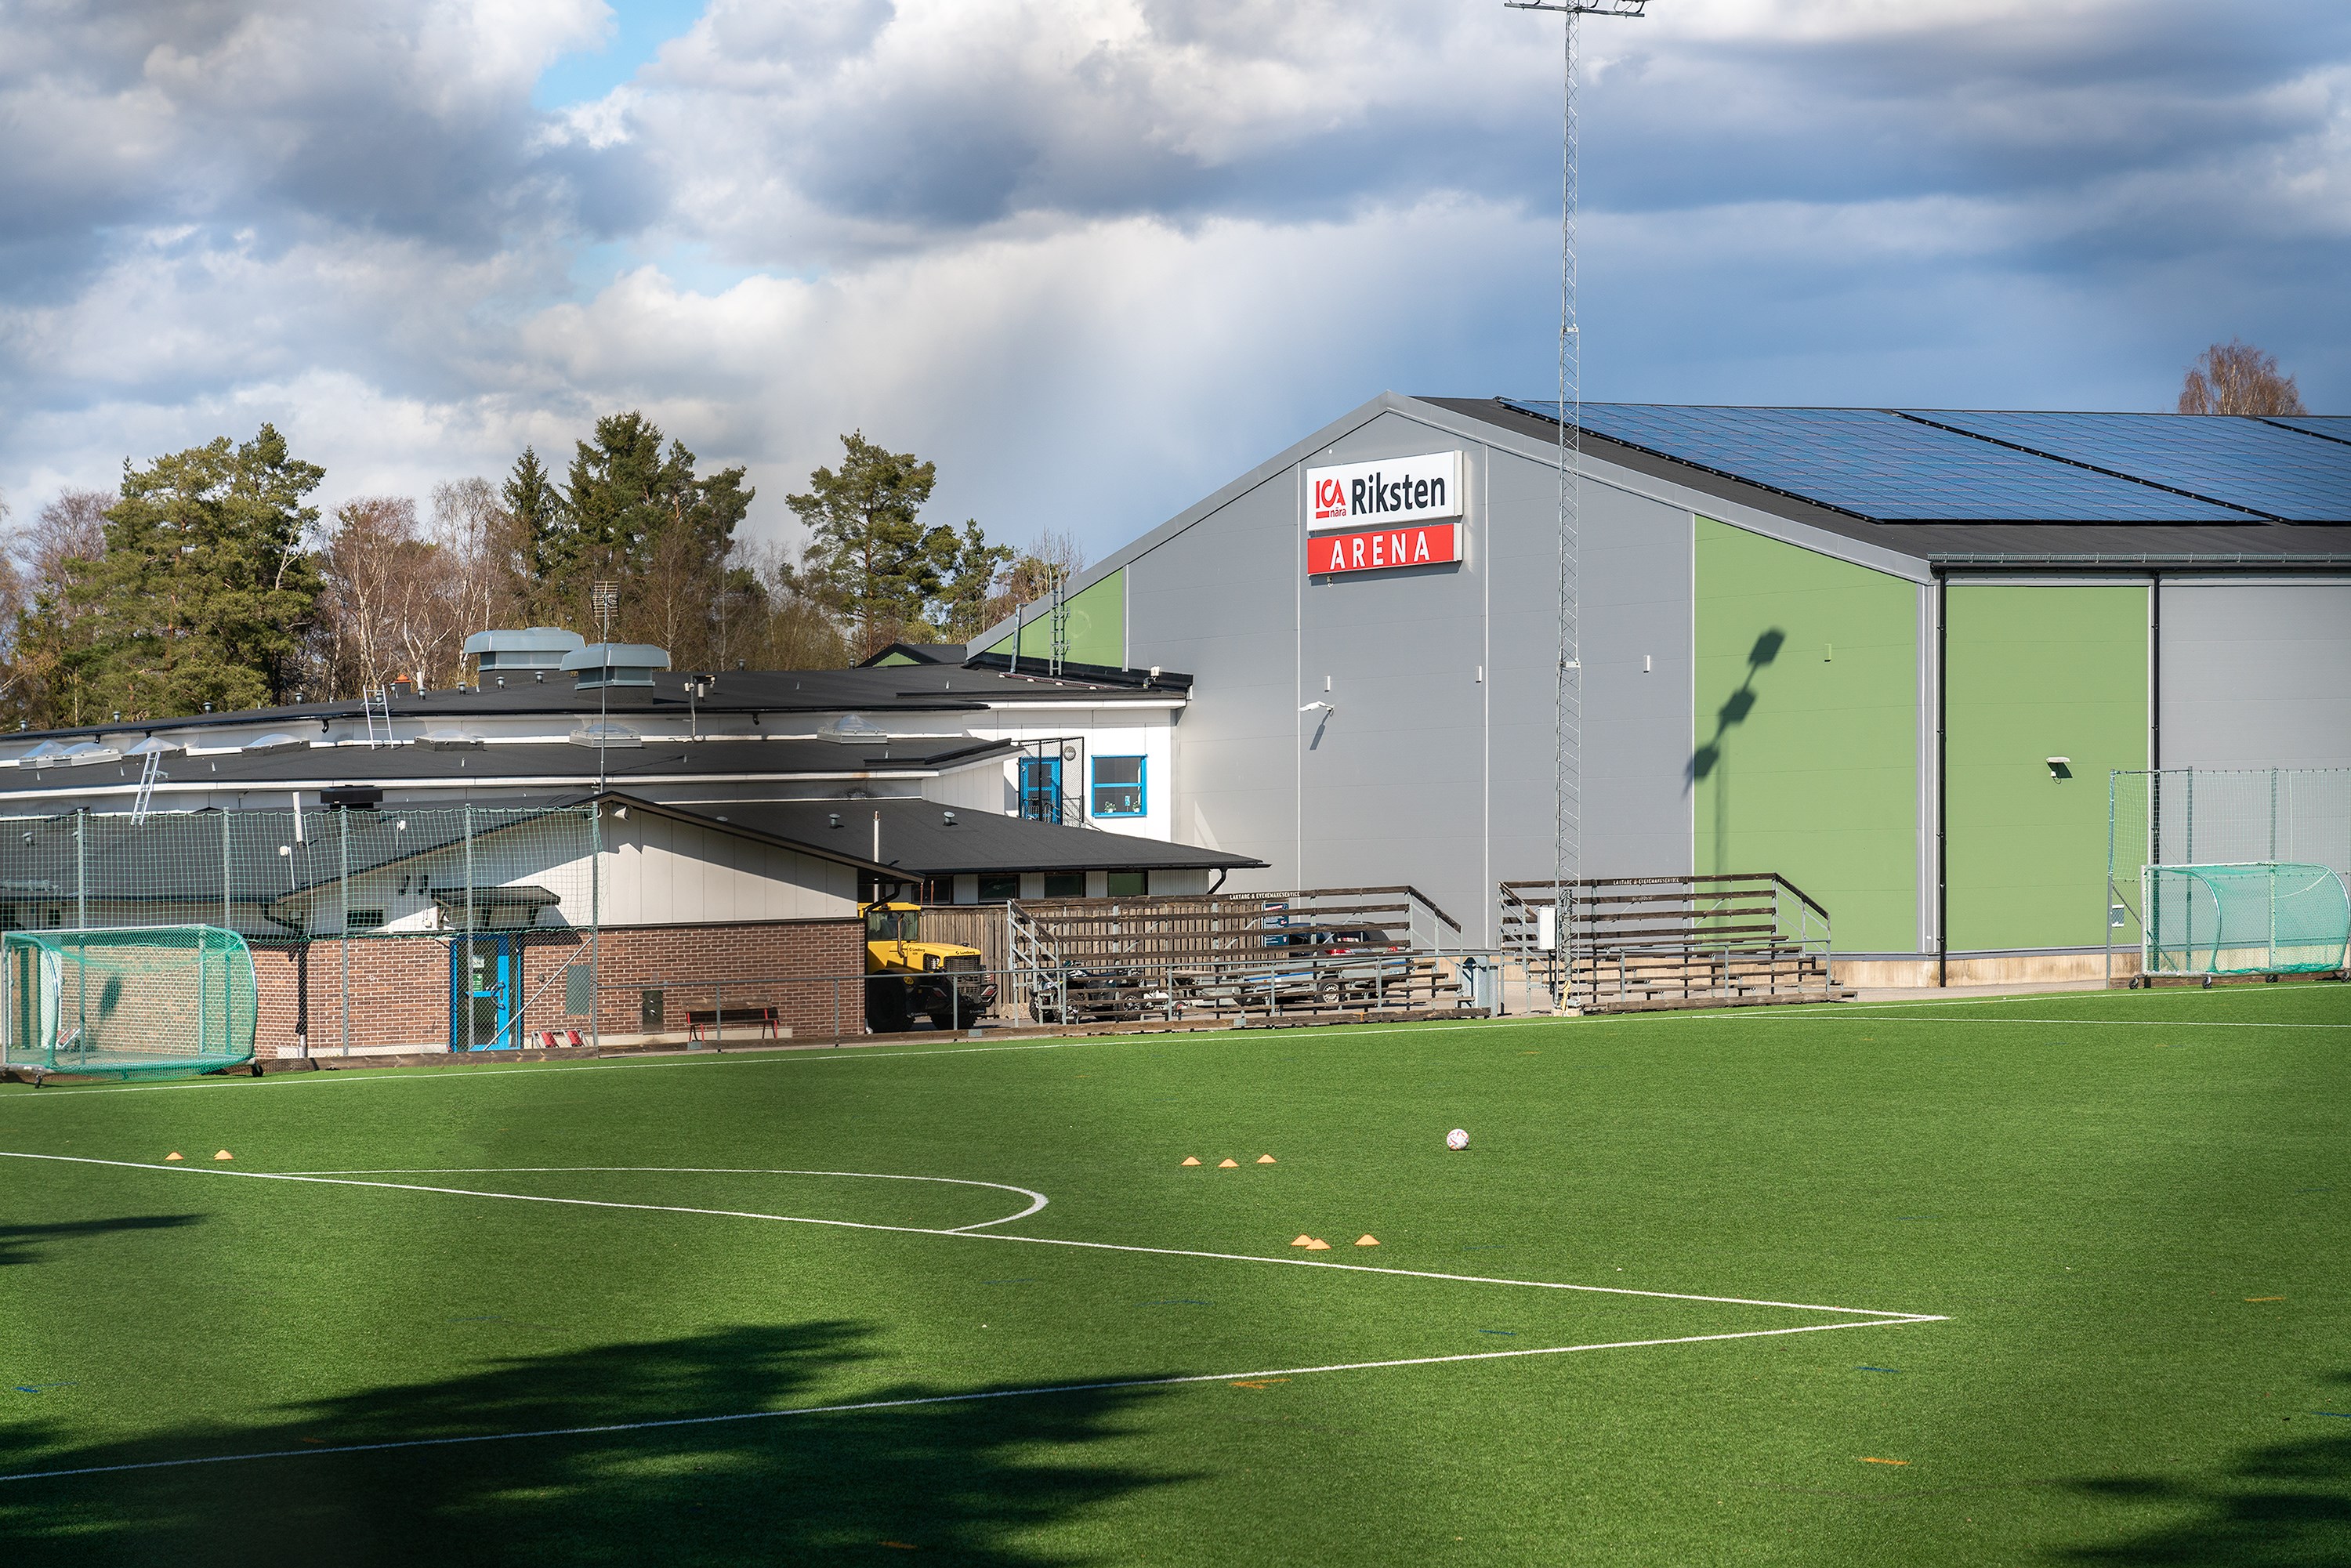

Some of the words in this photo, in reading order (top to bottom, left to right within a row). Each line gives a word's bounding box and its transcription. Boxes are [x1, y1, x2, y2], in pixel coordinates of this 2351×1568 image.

[1316, 479, 1346, 509] ICA
[1352, 472, 1445, 516] Riksten
[1330, 507, 1346, 518] nära
[1330, 531, 1430, 570] ARENA
